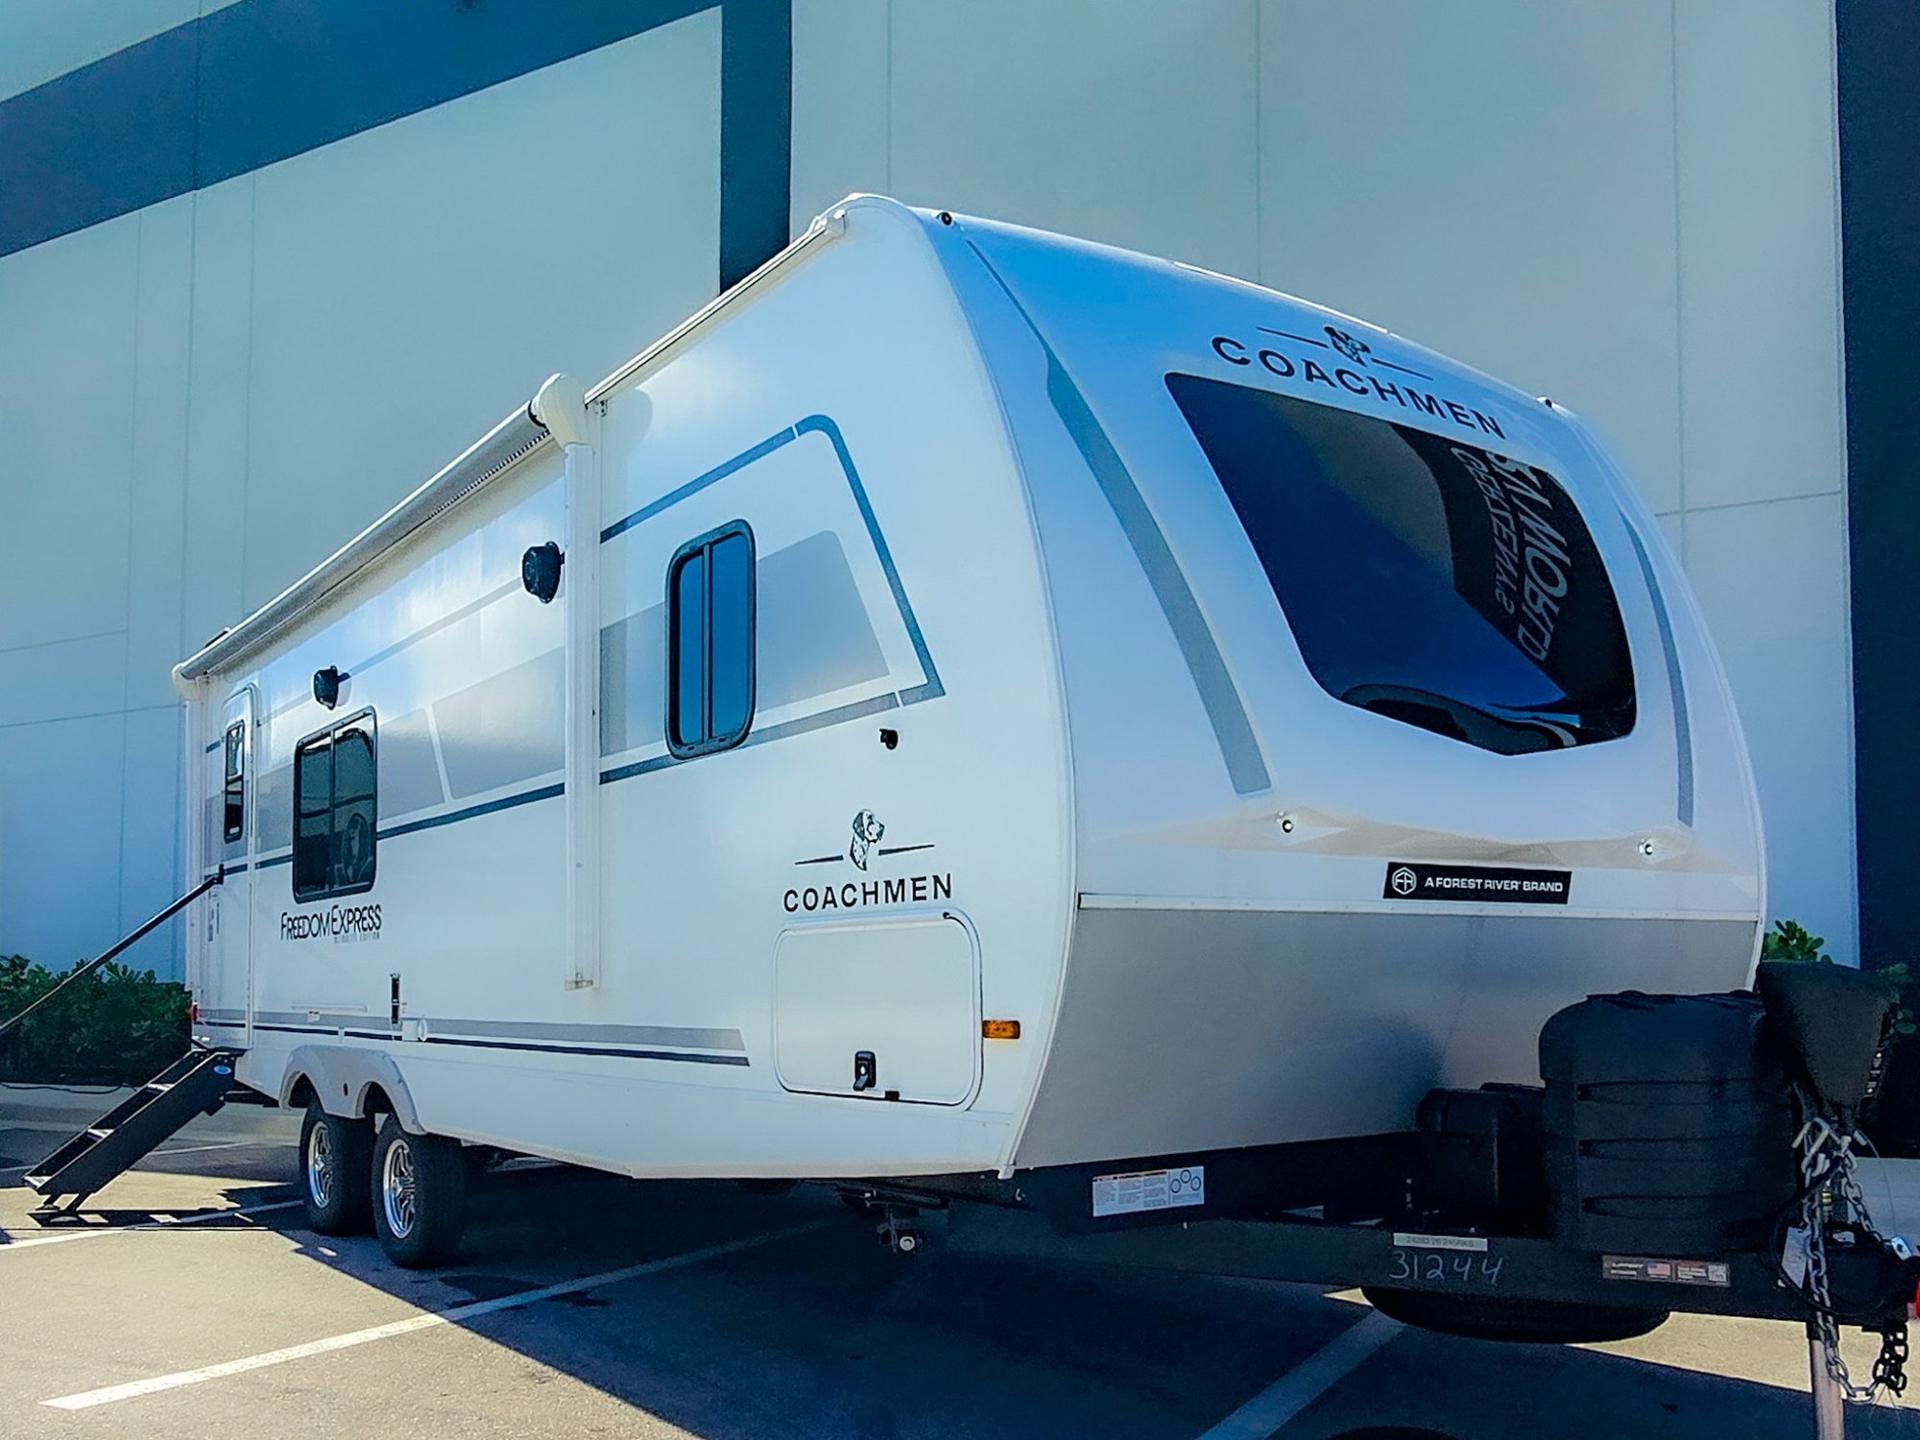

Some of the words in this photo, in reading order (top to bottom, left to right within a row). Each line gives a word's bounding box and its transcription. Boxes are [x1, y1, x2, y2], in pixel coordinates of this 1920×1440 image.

[1211, 336, 1506, 439] COACHMEN
[783, 873, 952, 913] COACHMEN
[1424, 876, 1435, 888] A
[1435, 877, 1484, 890] FOREST
[1522, 881, 1563, 893] BRAND
[1389, 1250, 1504, 1284] 31244
